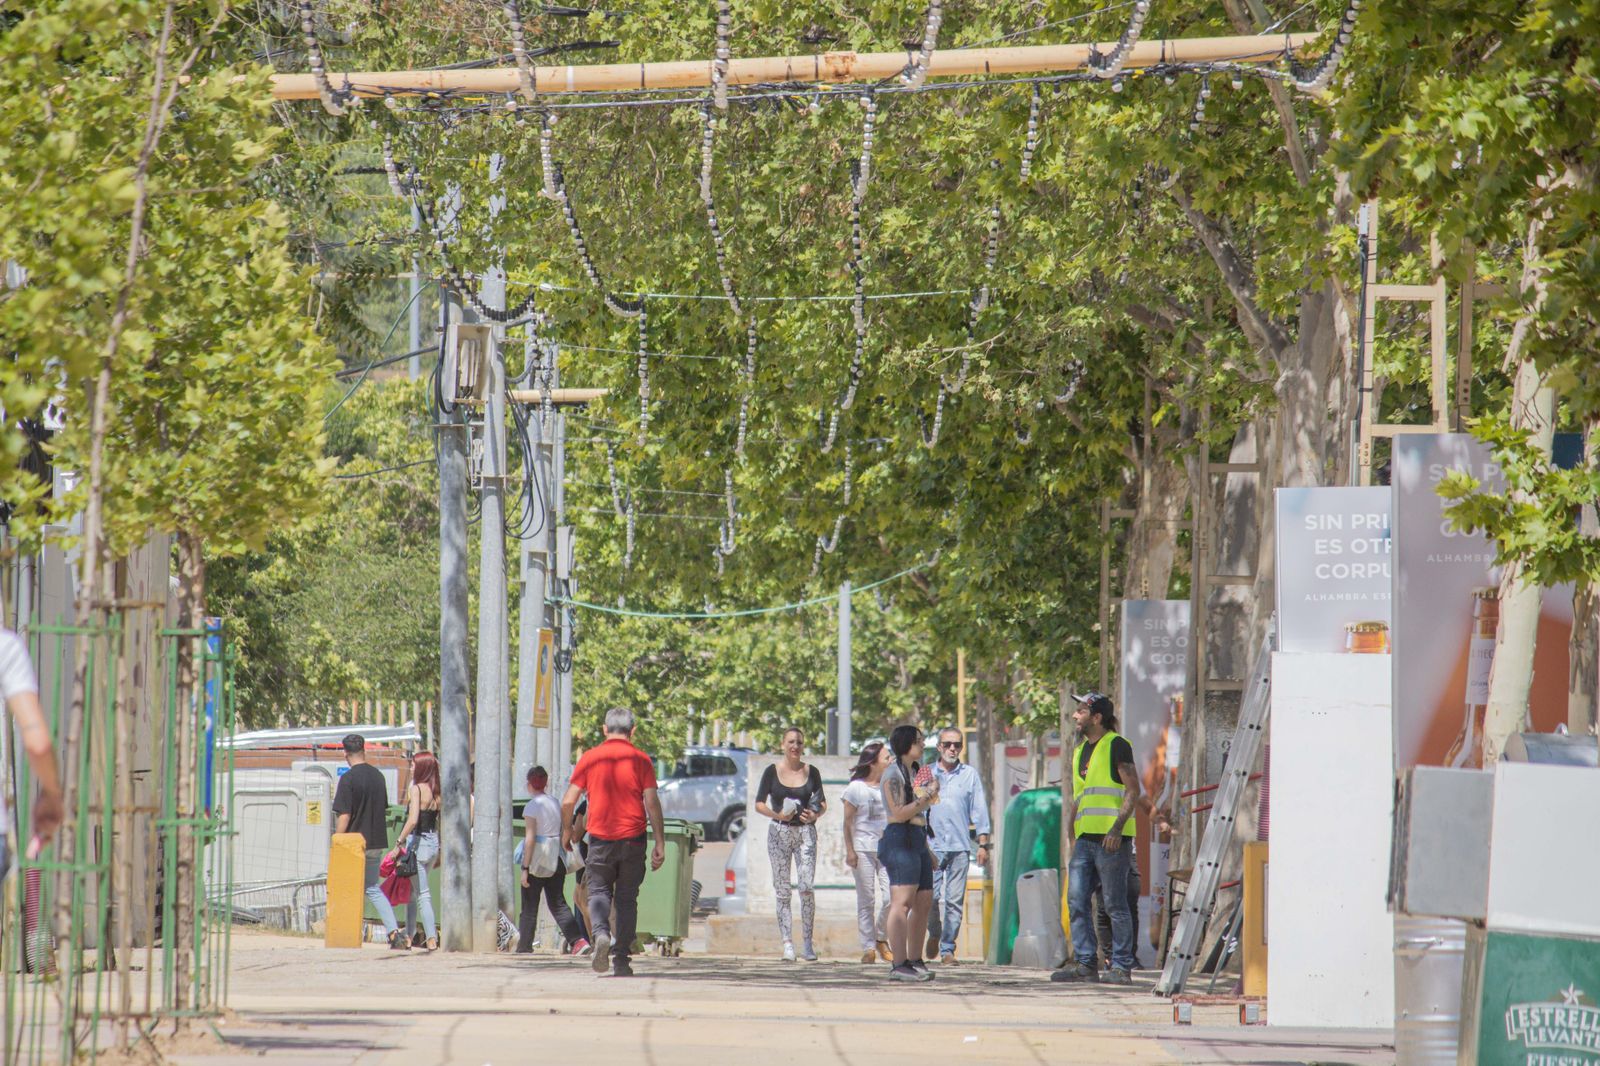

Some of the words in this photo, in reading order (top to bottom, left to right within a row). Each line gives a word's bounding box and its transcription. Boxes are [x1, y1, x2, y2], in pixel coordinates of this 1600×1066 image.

[1305, 514, 1343, 530] SIN
[1352, 513, 1388, 529] PRI
[1315, 538, 1343, 555] ES
[1315, 563, 1392, 579] CORPU
[1304, 593, 1368, 601] ALHAMBRA
[1151, 636, 1170, 648] ES
[1150, 653, 1187, 665] COR
[1529, 1026, 1600, 1048] LEVANTE
